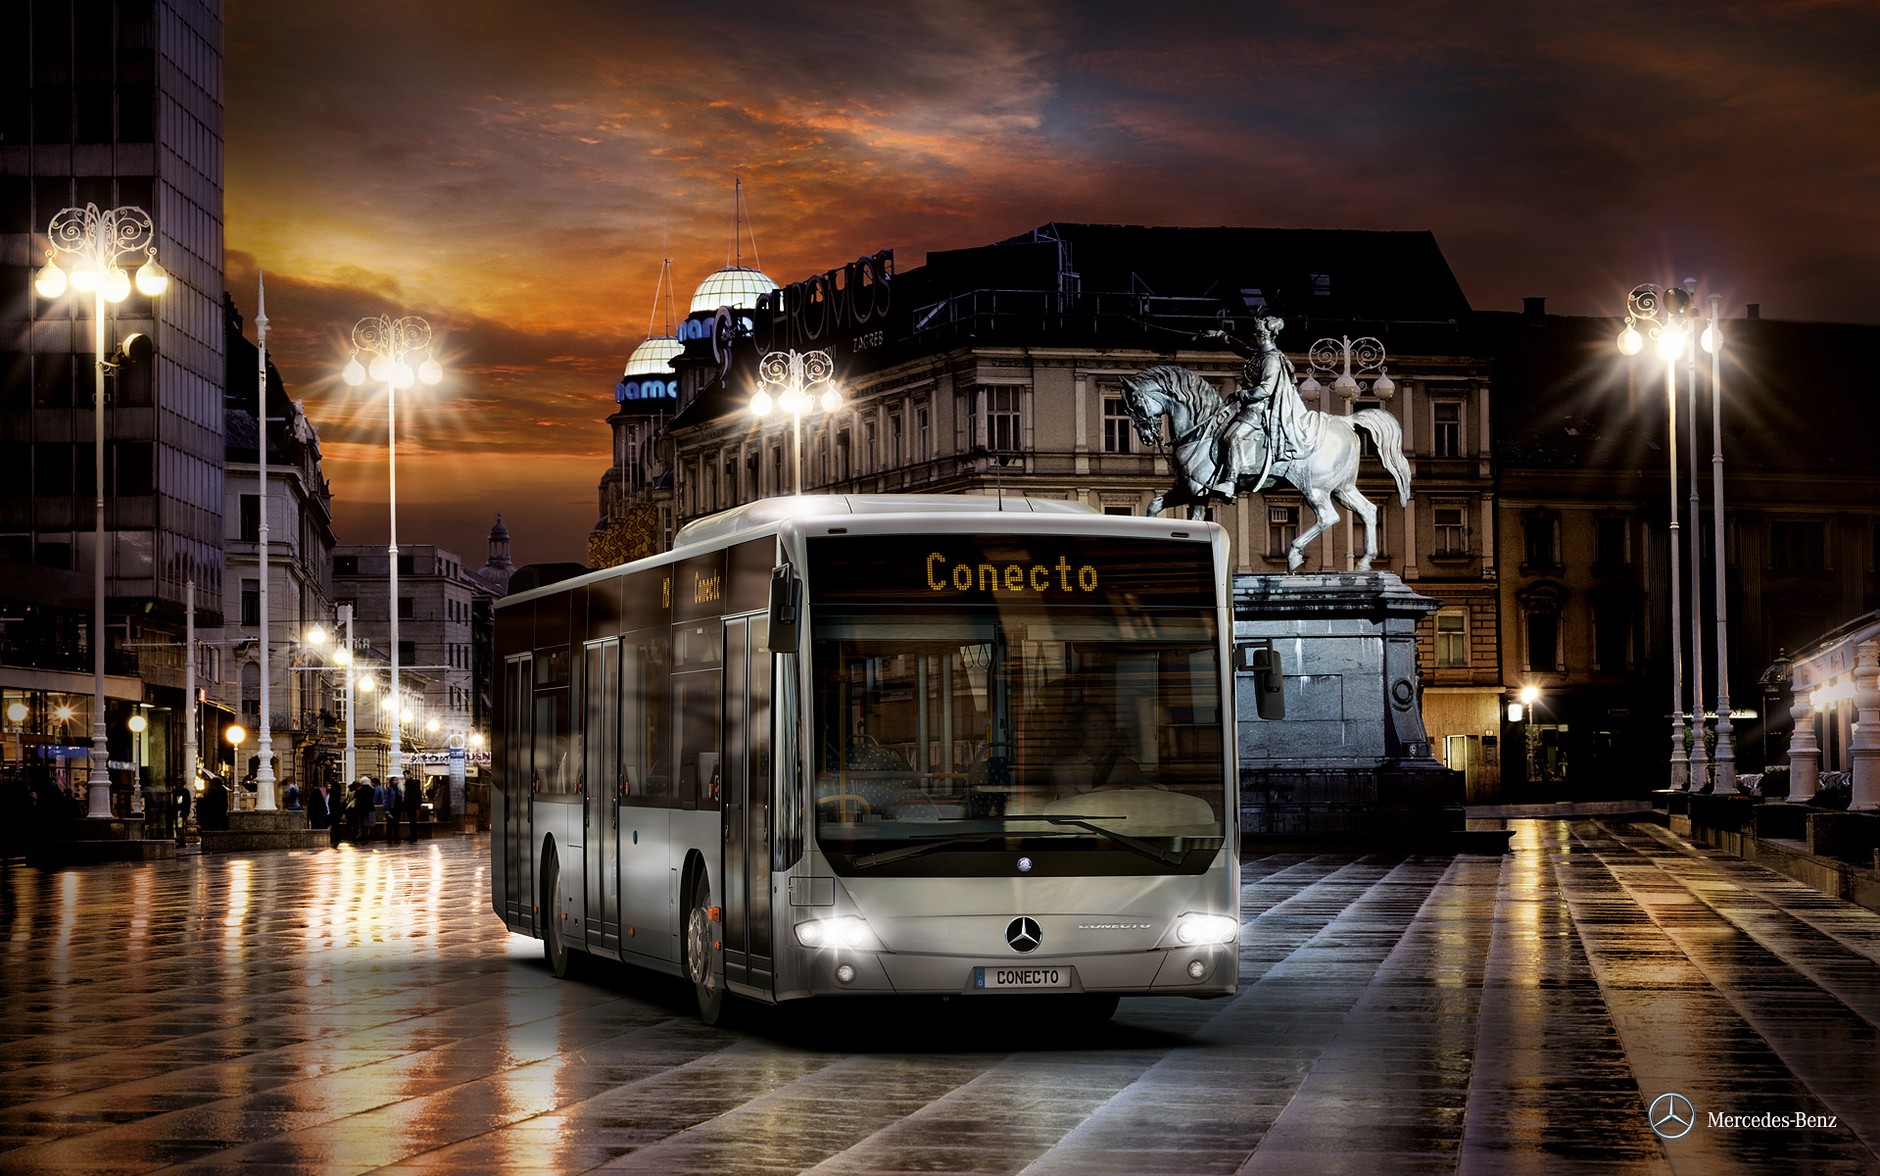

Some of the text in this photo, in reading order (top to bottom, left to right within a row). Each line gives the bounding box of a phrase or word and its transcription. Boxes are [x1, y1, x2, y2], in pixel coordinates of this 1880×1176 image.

[753, 249, 893, 355] CHROMOS
[853, 330, 884, 353] ZAGREB
[926, 552, 1098, 592] Conecto
[997, 970, 1059, 985] CONECTO
